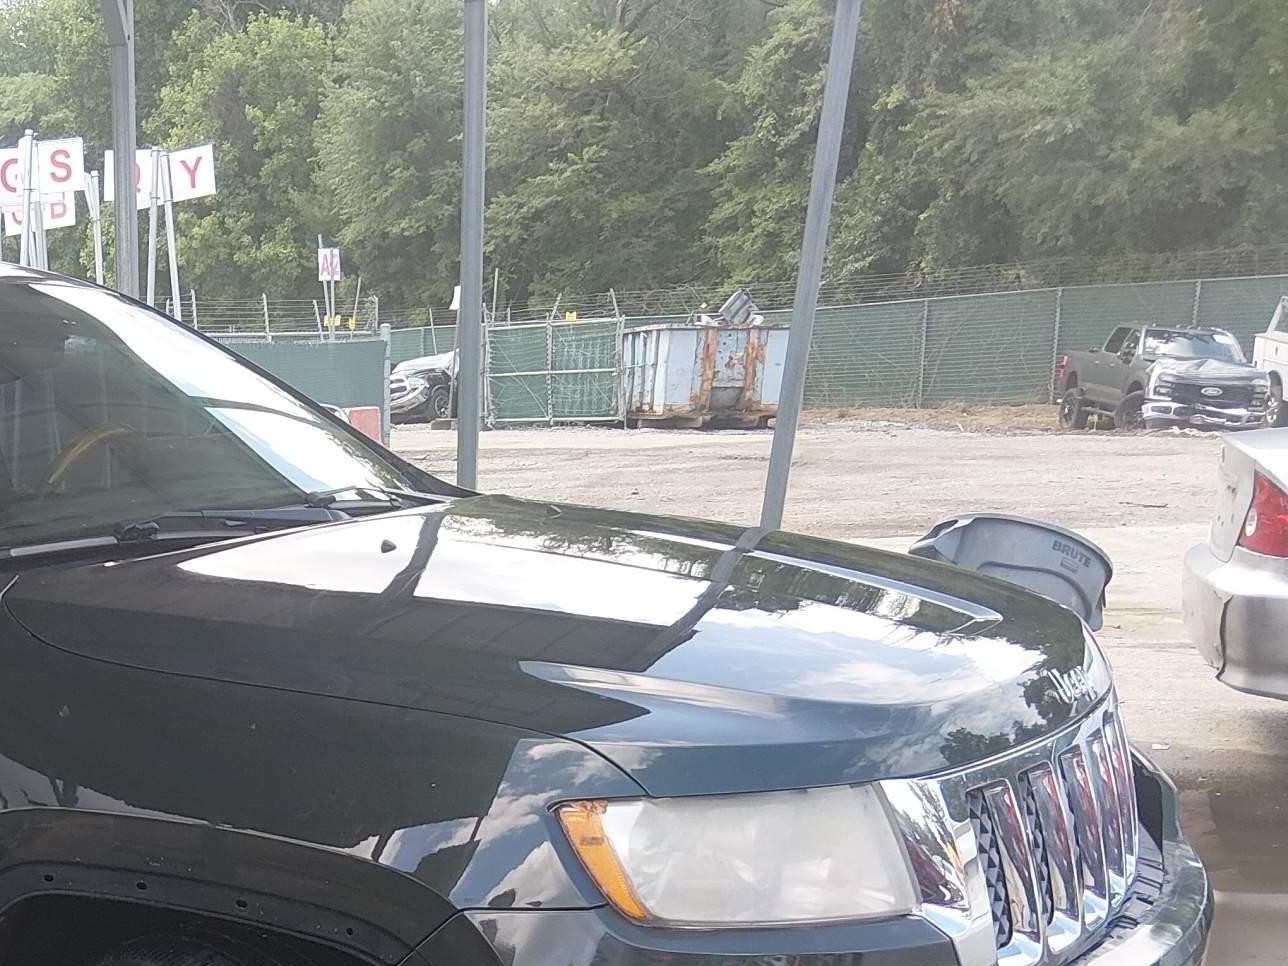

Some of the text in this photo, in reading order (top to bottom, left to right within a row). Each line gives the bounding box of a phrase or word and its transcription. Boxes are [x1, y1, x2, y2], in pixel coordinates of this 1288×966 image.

[49, 149, 73, 183] S
[179, 155, 203, 189] Y
[1051, 539, 1092, 569] BRUTE
